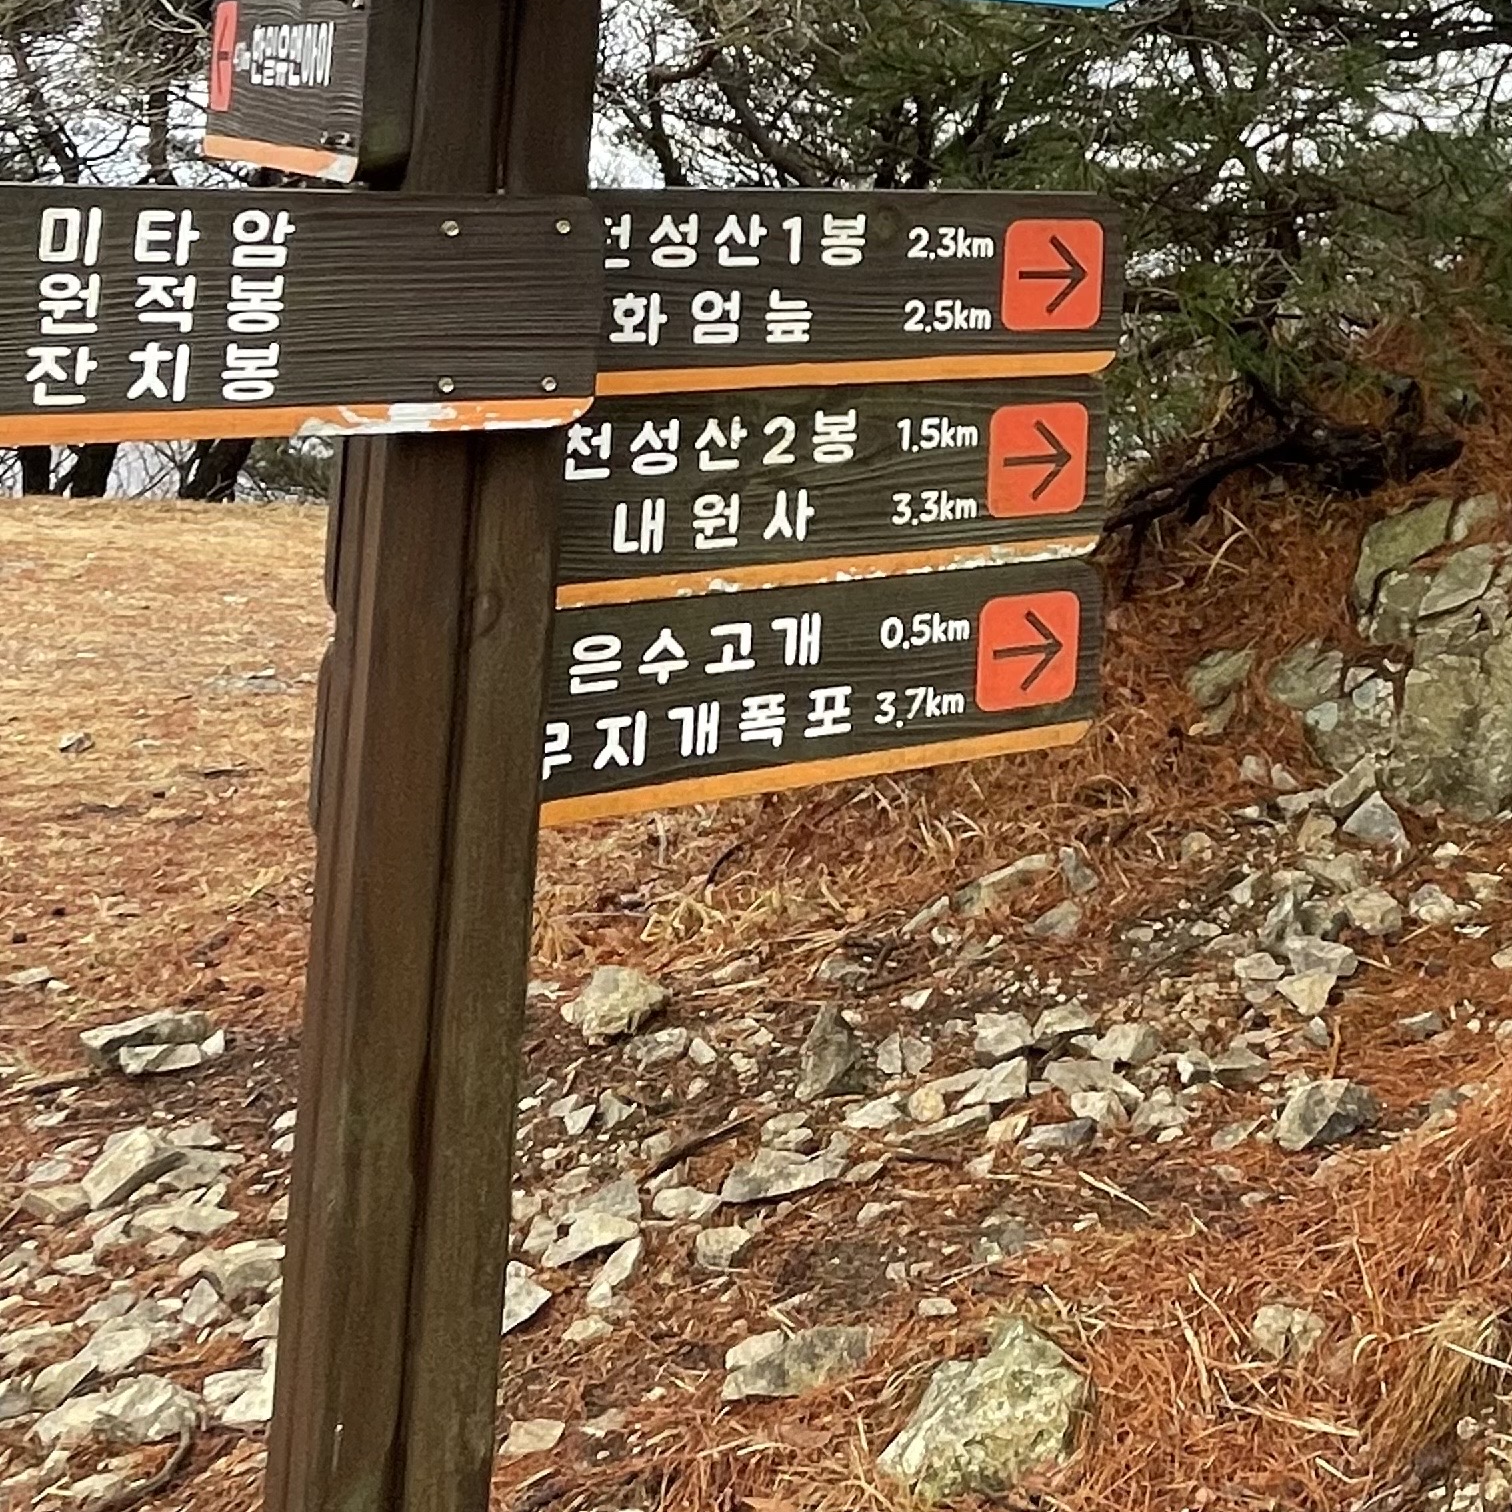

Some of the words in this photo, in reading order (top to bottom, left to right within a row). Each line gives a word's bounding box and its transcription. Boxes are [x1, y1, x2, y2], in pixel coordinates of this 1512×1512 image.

[38, 206, 296, 268] 미타암
[907, 226, 994, 260] 2.3km
[38, 273, 285, 335] 원적봉
[609, 288, 813, 346] 화엄늪
[903, 299, 993, 334] 2.5km
[25, 341, 280, 406] 잔치봉
[564, 408, 859, 481] 천성산2봉
[897, 416, 979, 454] 1.5km
[613, 488, 815, 555] 내원사
[891, 490, 978, 526] 3.3km
[568, 612, 823, 695] 은수고개
[880, 612, 971, 651] 0.5km
[874, 686, 966, 729] 3.7km
